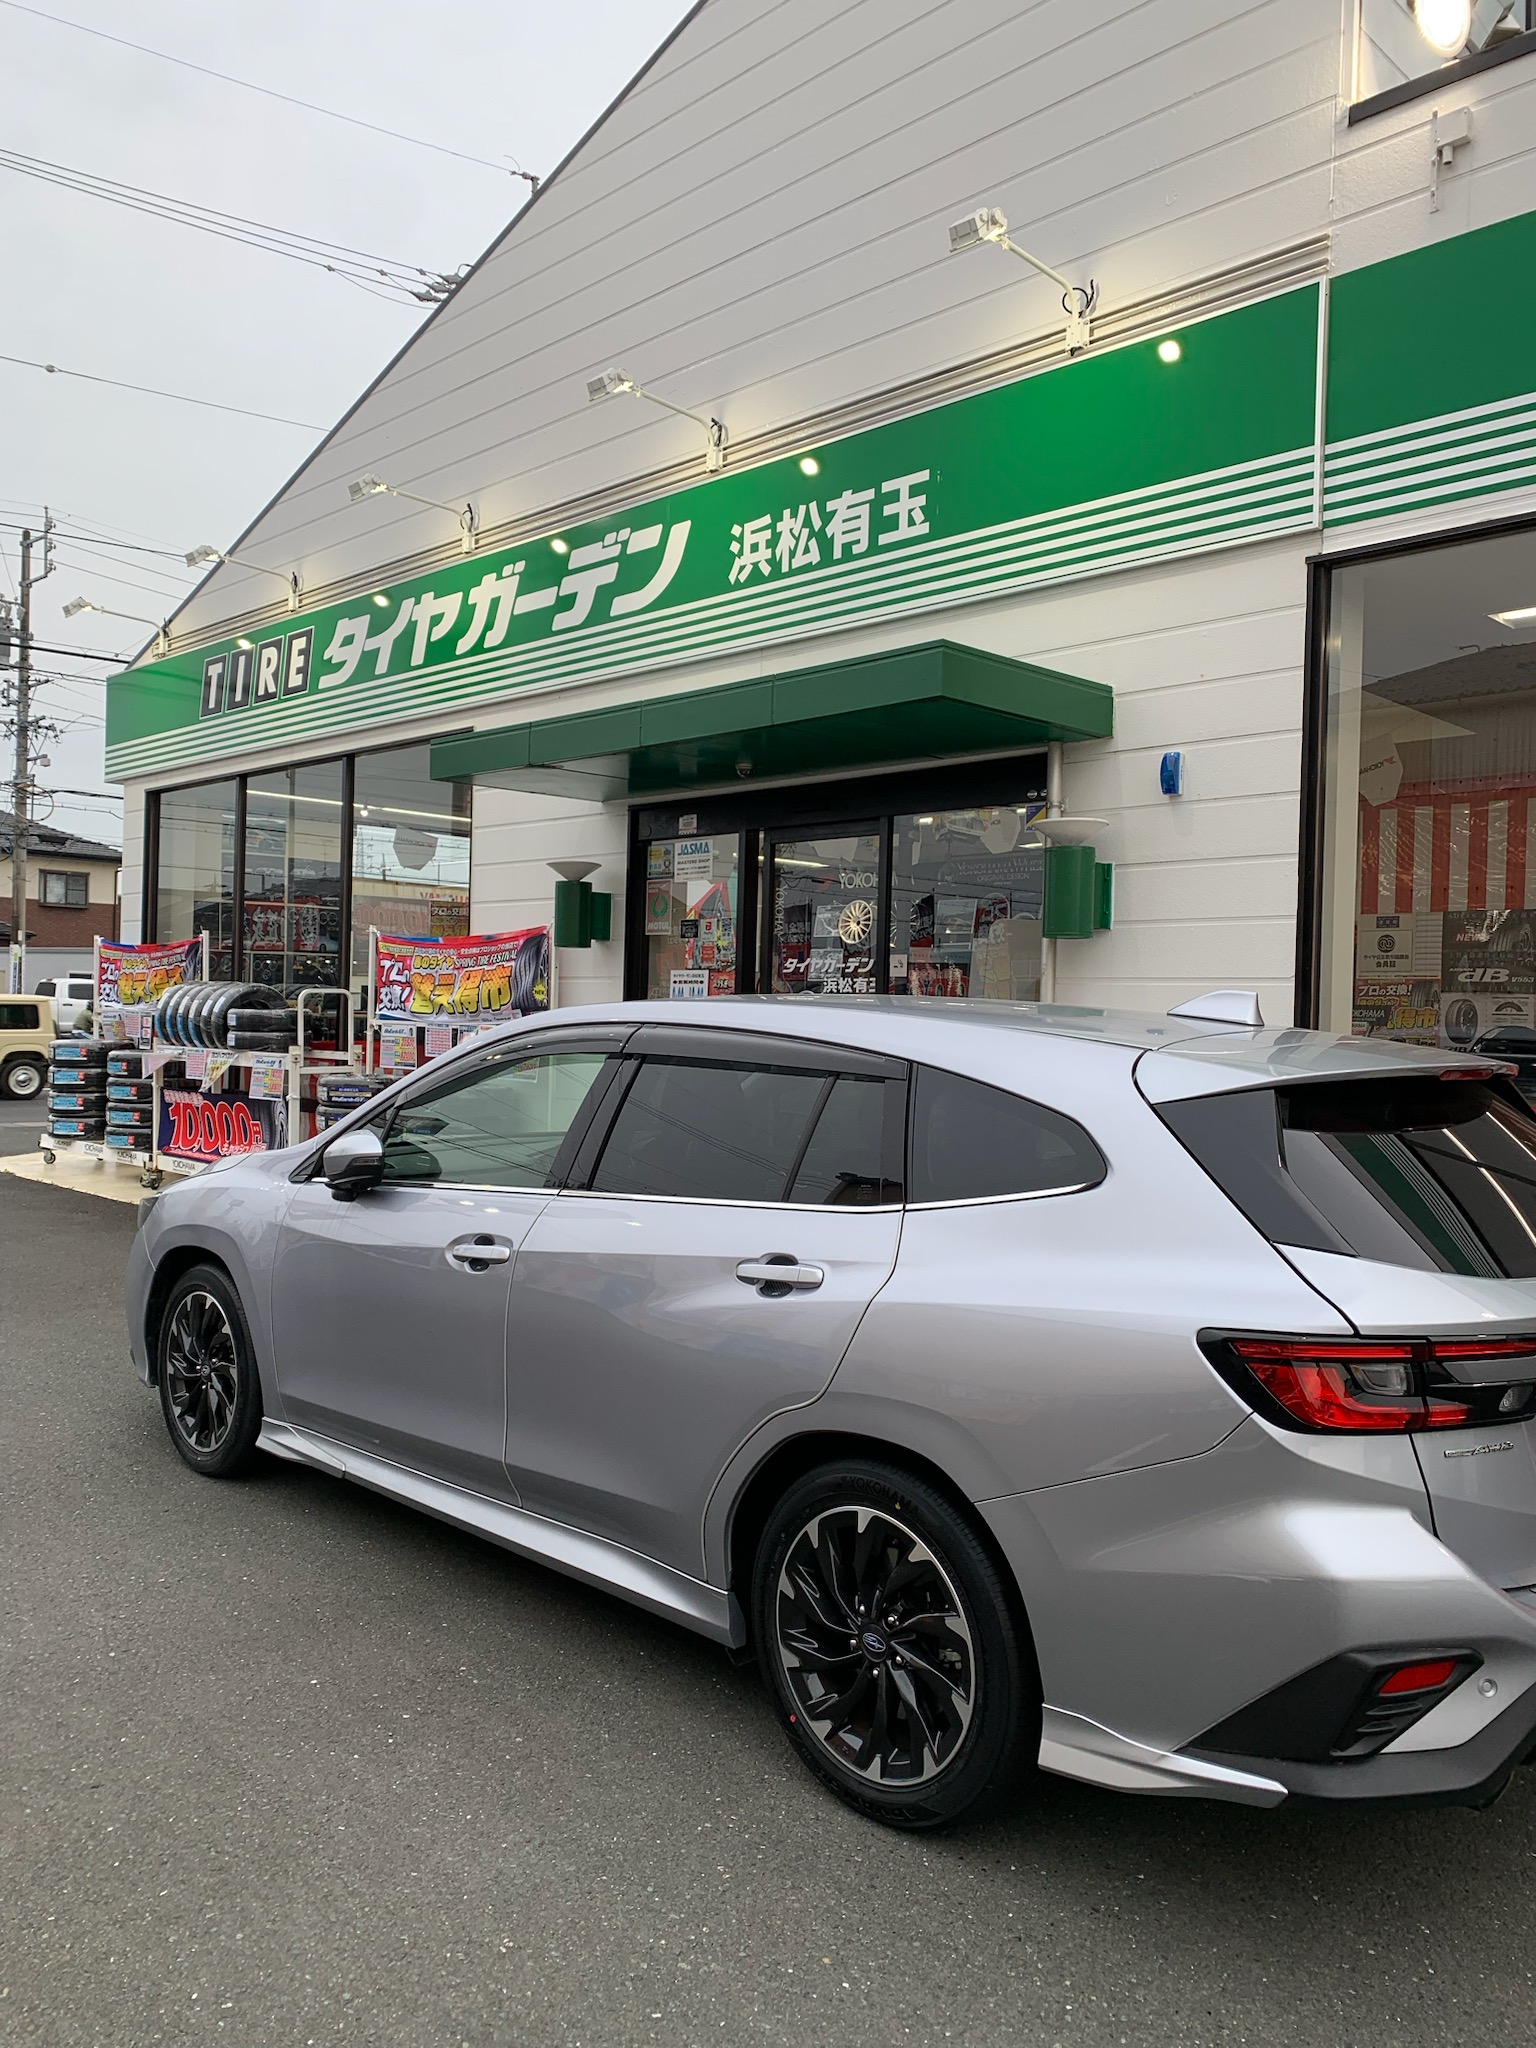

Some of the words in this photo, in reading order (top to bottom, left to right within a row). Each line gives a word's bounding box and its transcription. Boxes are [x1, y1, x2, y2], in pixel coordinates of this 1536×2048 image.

[728, 468, 931, 586] 浜松有玉
[317, 519, 692, 690] タイヤガーデン
[204, 637, 309, 711] TIRE
[678, 841, 710, 856] JASMA
